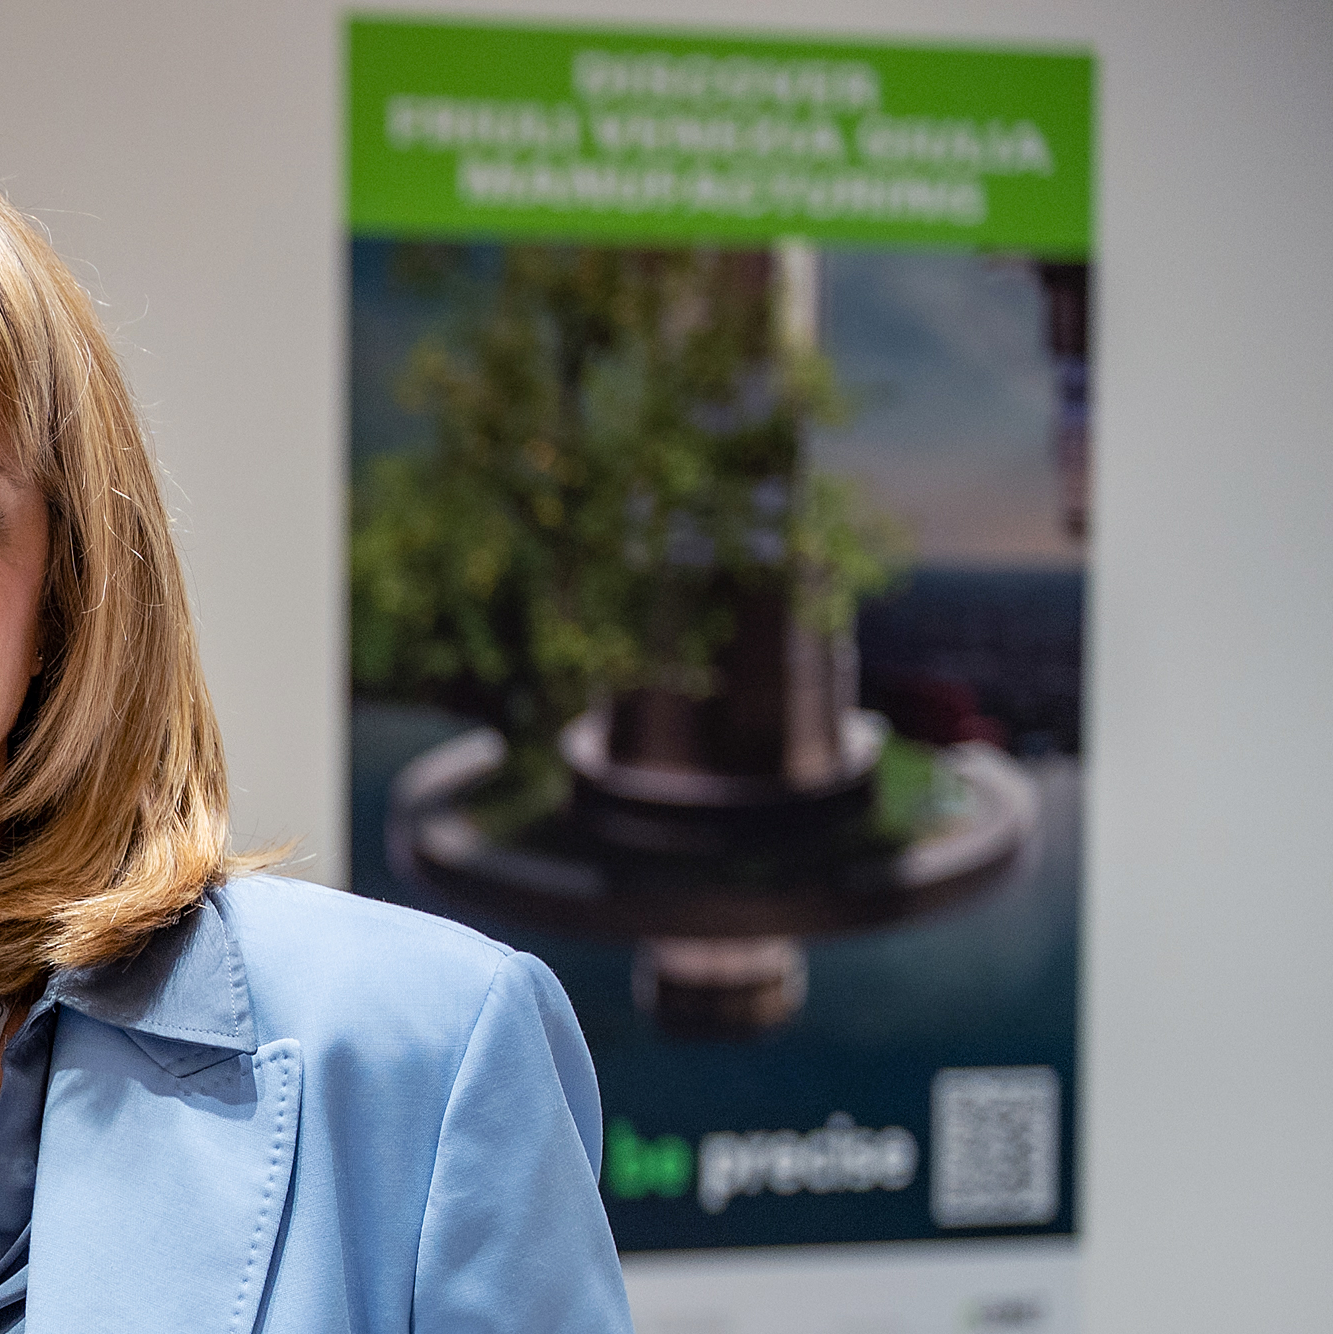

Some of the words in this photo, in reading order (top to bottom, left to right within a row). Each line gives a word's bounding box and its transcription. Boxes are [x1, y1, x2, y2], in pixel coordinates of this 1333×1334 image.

[571, 50, 881, 110] DISCOVER
[457, 153, 989, 225] MANUFACTURING
[607, 1115, 693, 1200] be
[697, 1110, 919, 1216] precise
